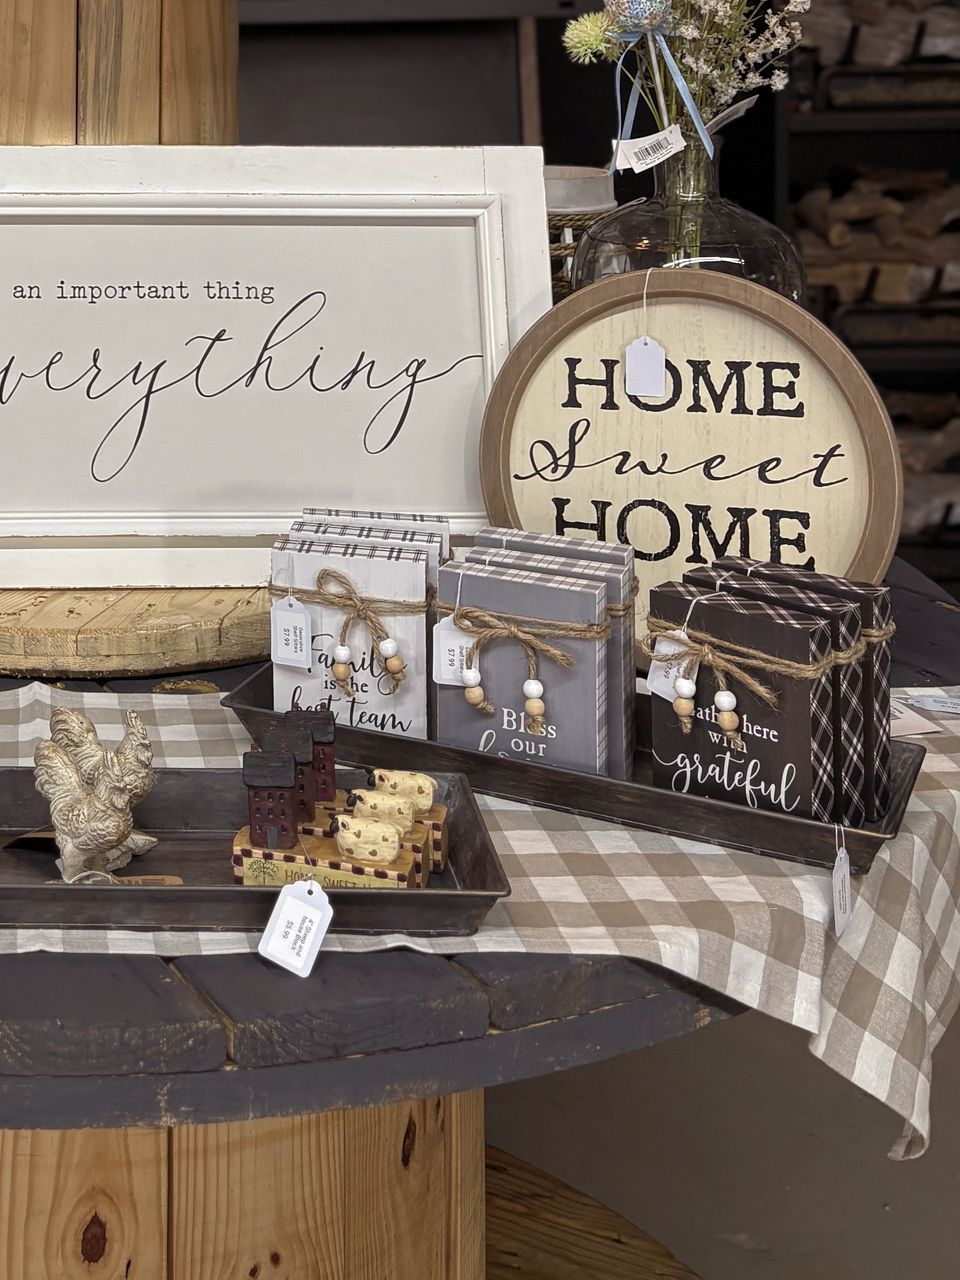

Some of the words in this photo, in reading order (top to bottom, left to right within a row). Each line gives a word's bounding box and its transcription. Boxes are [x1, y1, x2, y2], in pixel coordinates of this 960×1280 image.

[12, 285, 42, 300] an
[56, 280, 190, 303] important
[203, 280, 275, 304] thing
[513, 418, 849, 487] Sweet
[551, 497, 816, 572] HOME
[664, 660, 673, 679] $7.99
[324, 674, 337, 690] is
[349, 675, 369, 693] he
[345, 697, 413, 732] team
[742, 713, 780, 743] here
[511, 738, 547, 757] our
[652, 750, 800, 812] grateful
[282, 920, 294, 939] $5.99
[296, 944, 304, 958] and
